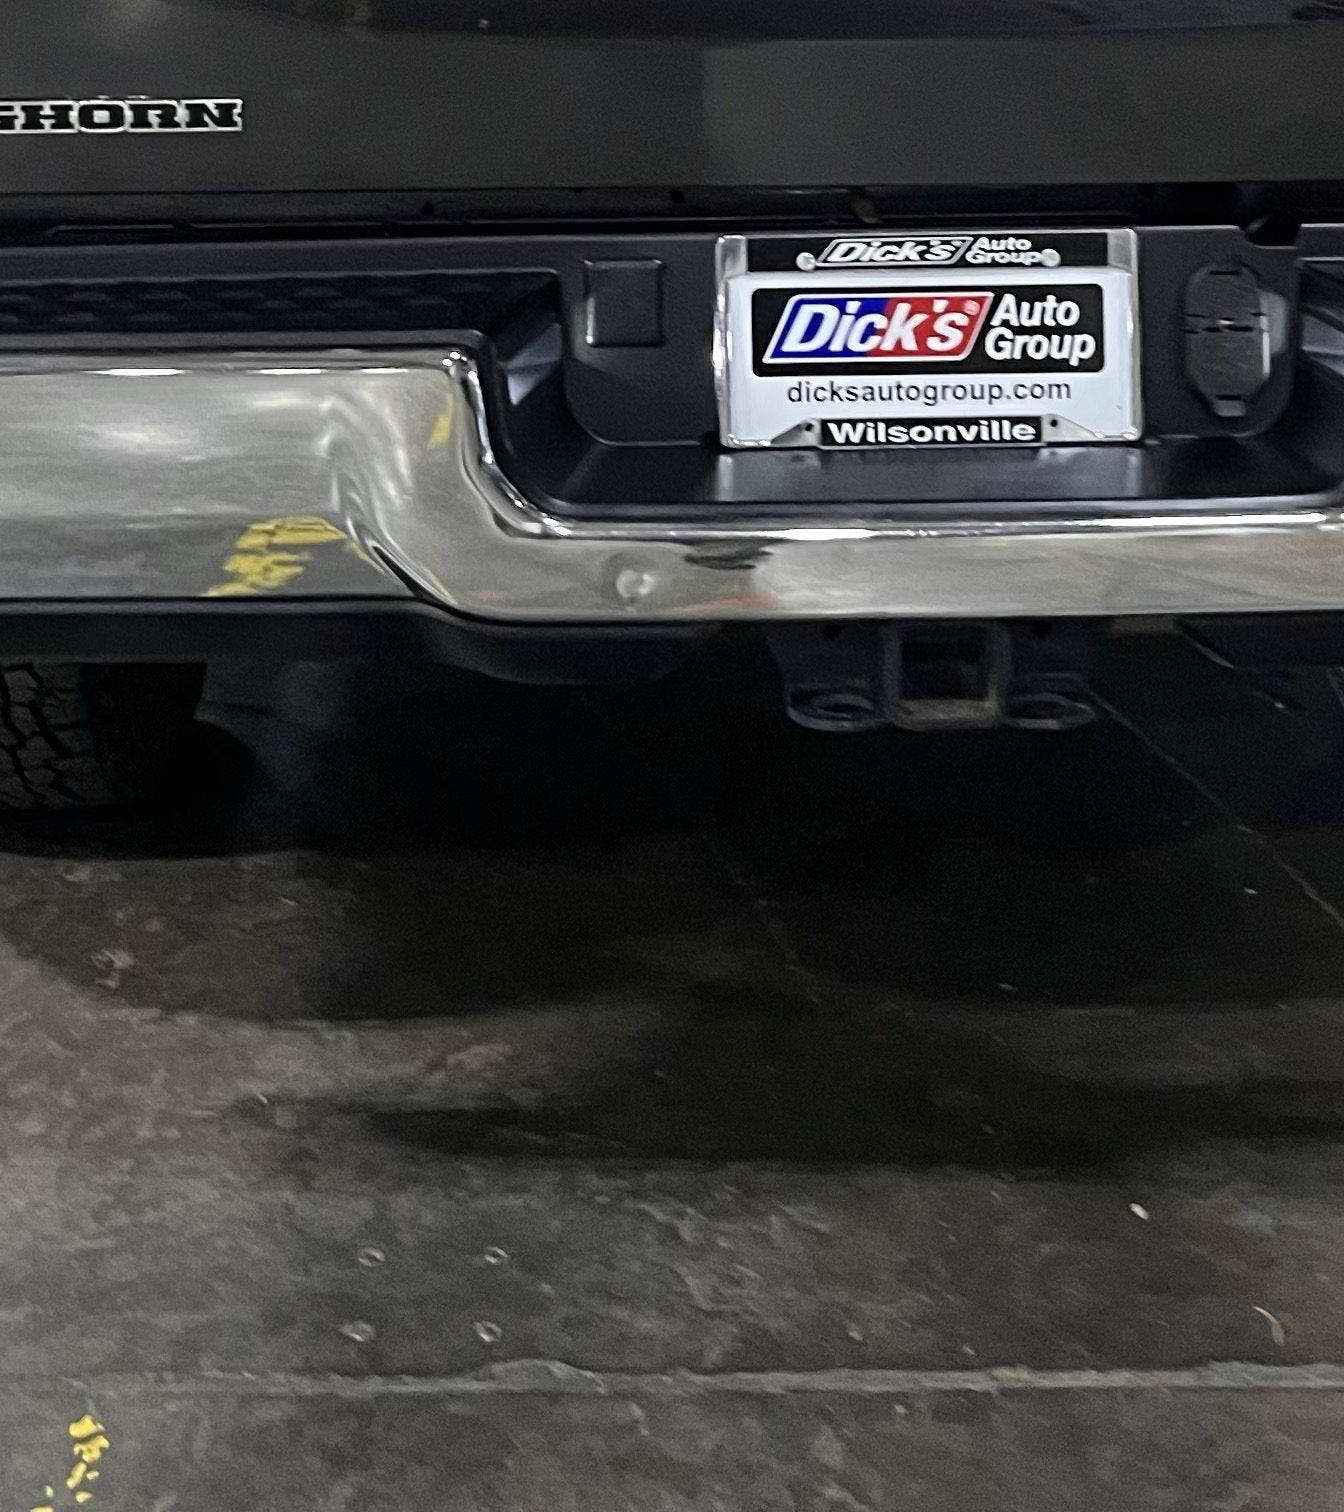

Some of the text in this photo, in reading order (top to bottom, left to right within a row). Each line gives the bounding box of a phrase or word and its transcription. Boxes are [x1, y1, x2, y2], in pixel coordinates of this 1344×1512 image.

[826, 236, 1032, 262] Dick's Auto
[965, 249, 1043, 266] Group
[780, 293, 1081, 352] Dick's Auto
[984, 326, 1096, 367] Group
[787, 381, 1072, 406] dicksautogroup.com
[827, 419, 1037, 445] Wilsonville
